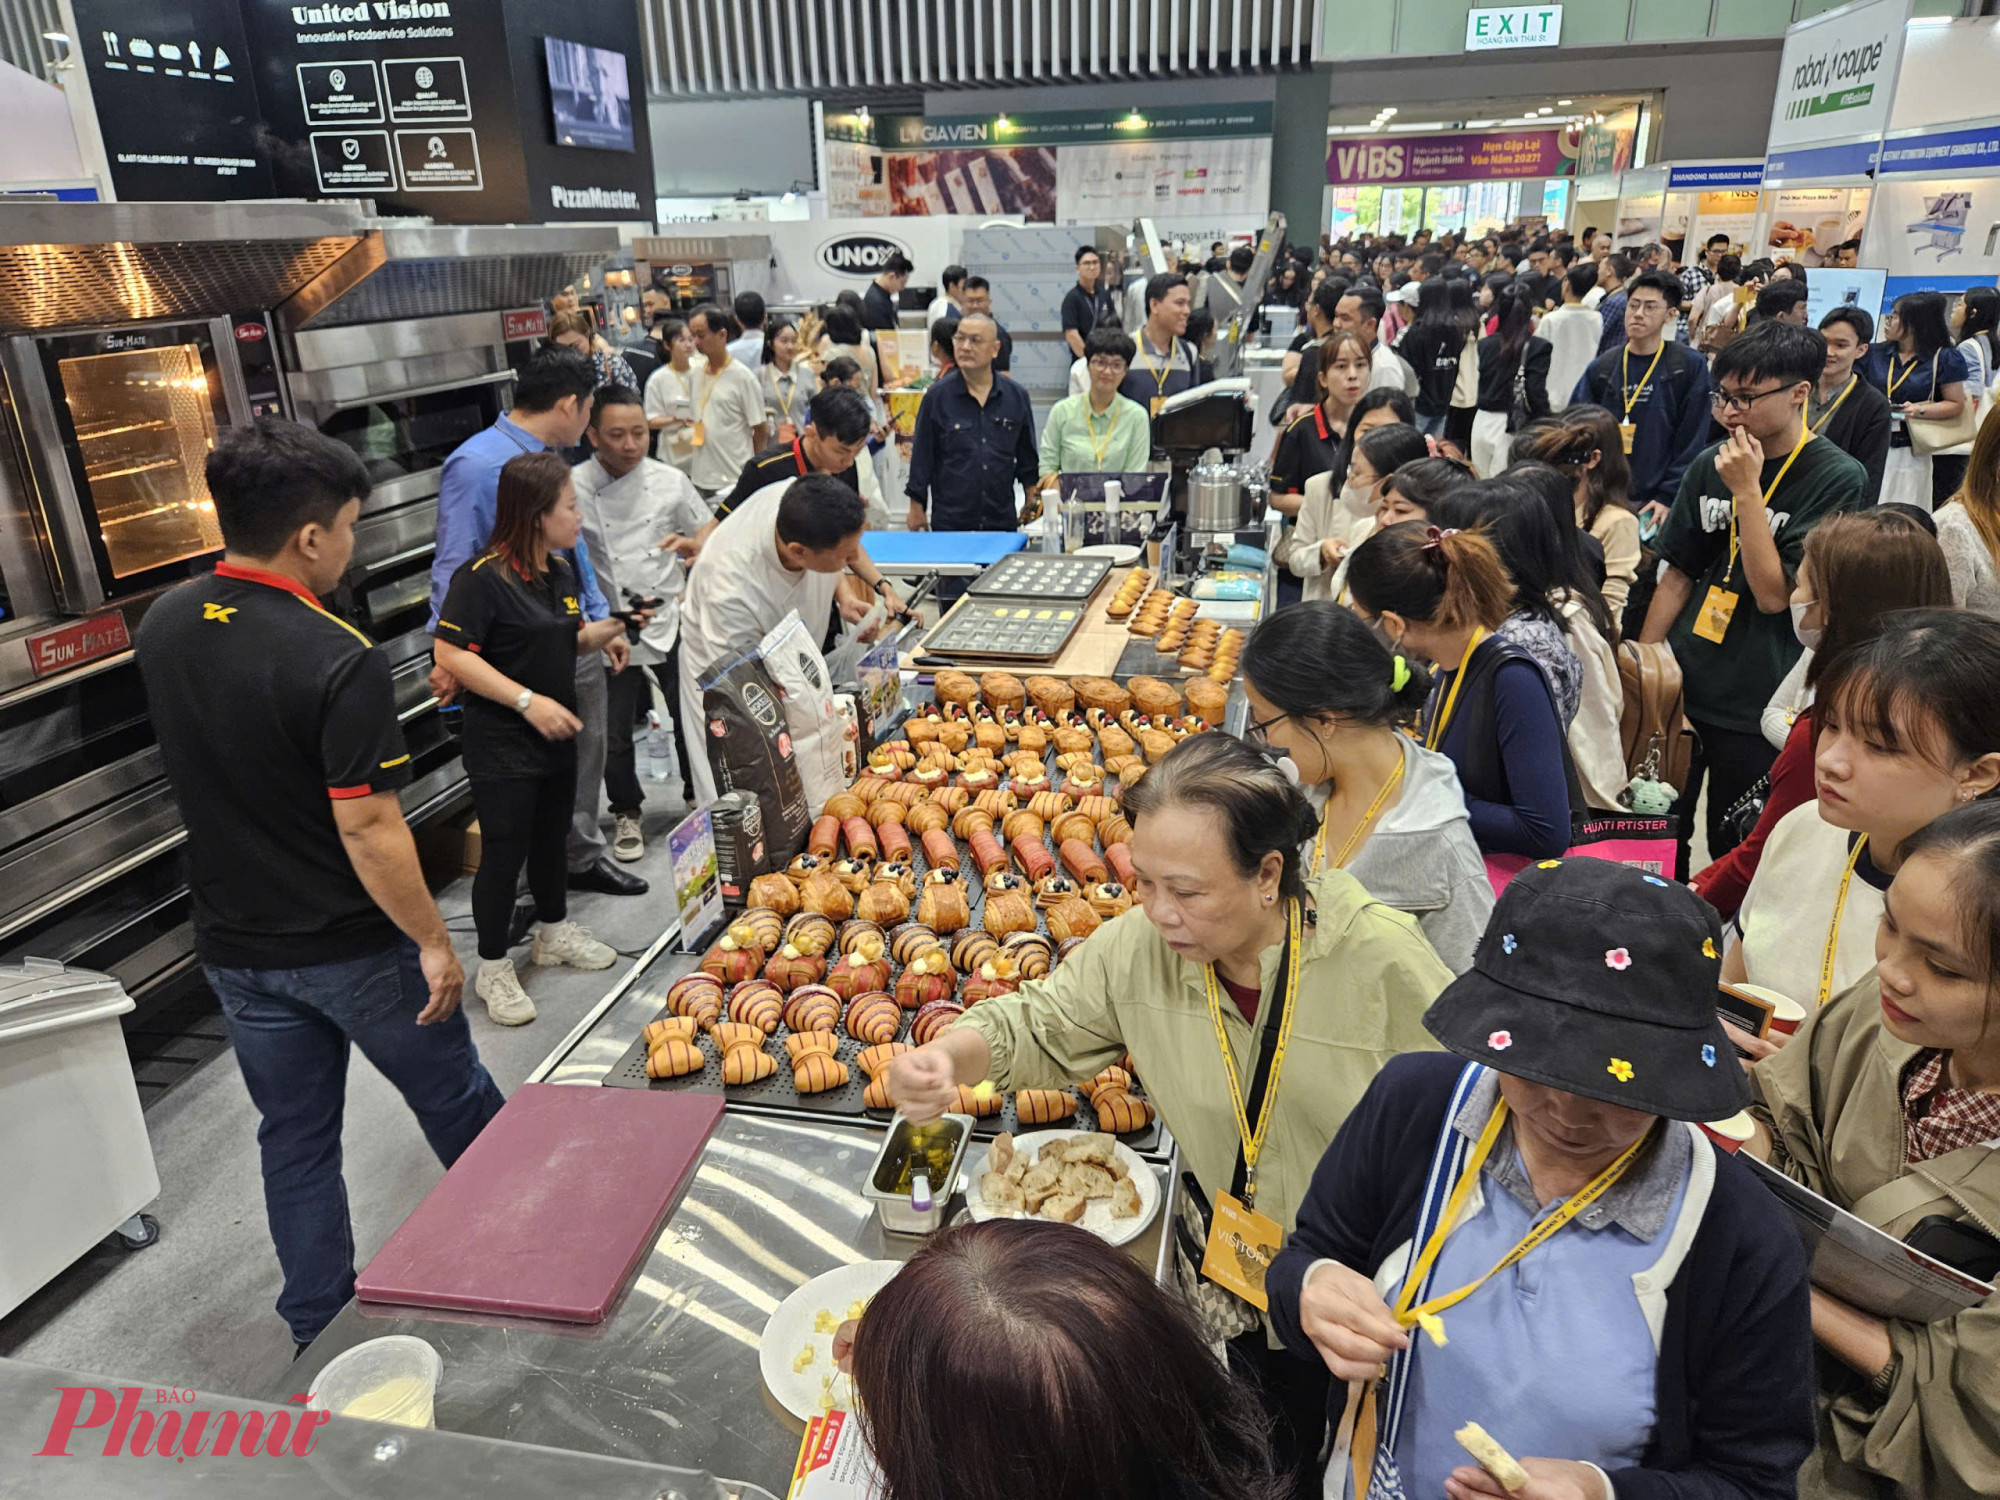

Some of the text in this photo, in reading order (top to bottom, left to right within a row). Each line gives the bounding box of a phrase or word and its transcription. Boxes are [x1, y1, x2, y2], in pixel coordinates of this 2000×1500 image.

[292, 0, 451, 24] United Vision
[1476, 12, 1553, 36] EXIT
[296, 26, 454, 43] Innovative Foodservice Solutions
[1791, 41, 1882, 91] robot coupe
[1337, 144, 1404, 180] VIBS
[1742, 171, 1762, 179] DAIRY
[825, 245, 895, 267] UNOX
[1217, 1227, 1267, 1266] VISITOR
[829, 1421, 854, 1481] BAKERY EQUIPMENT
